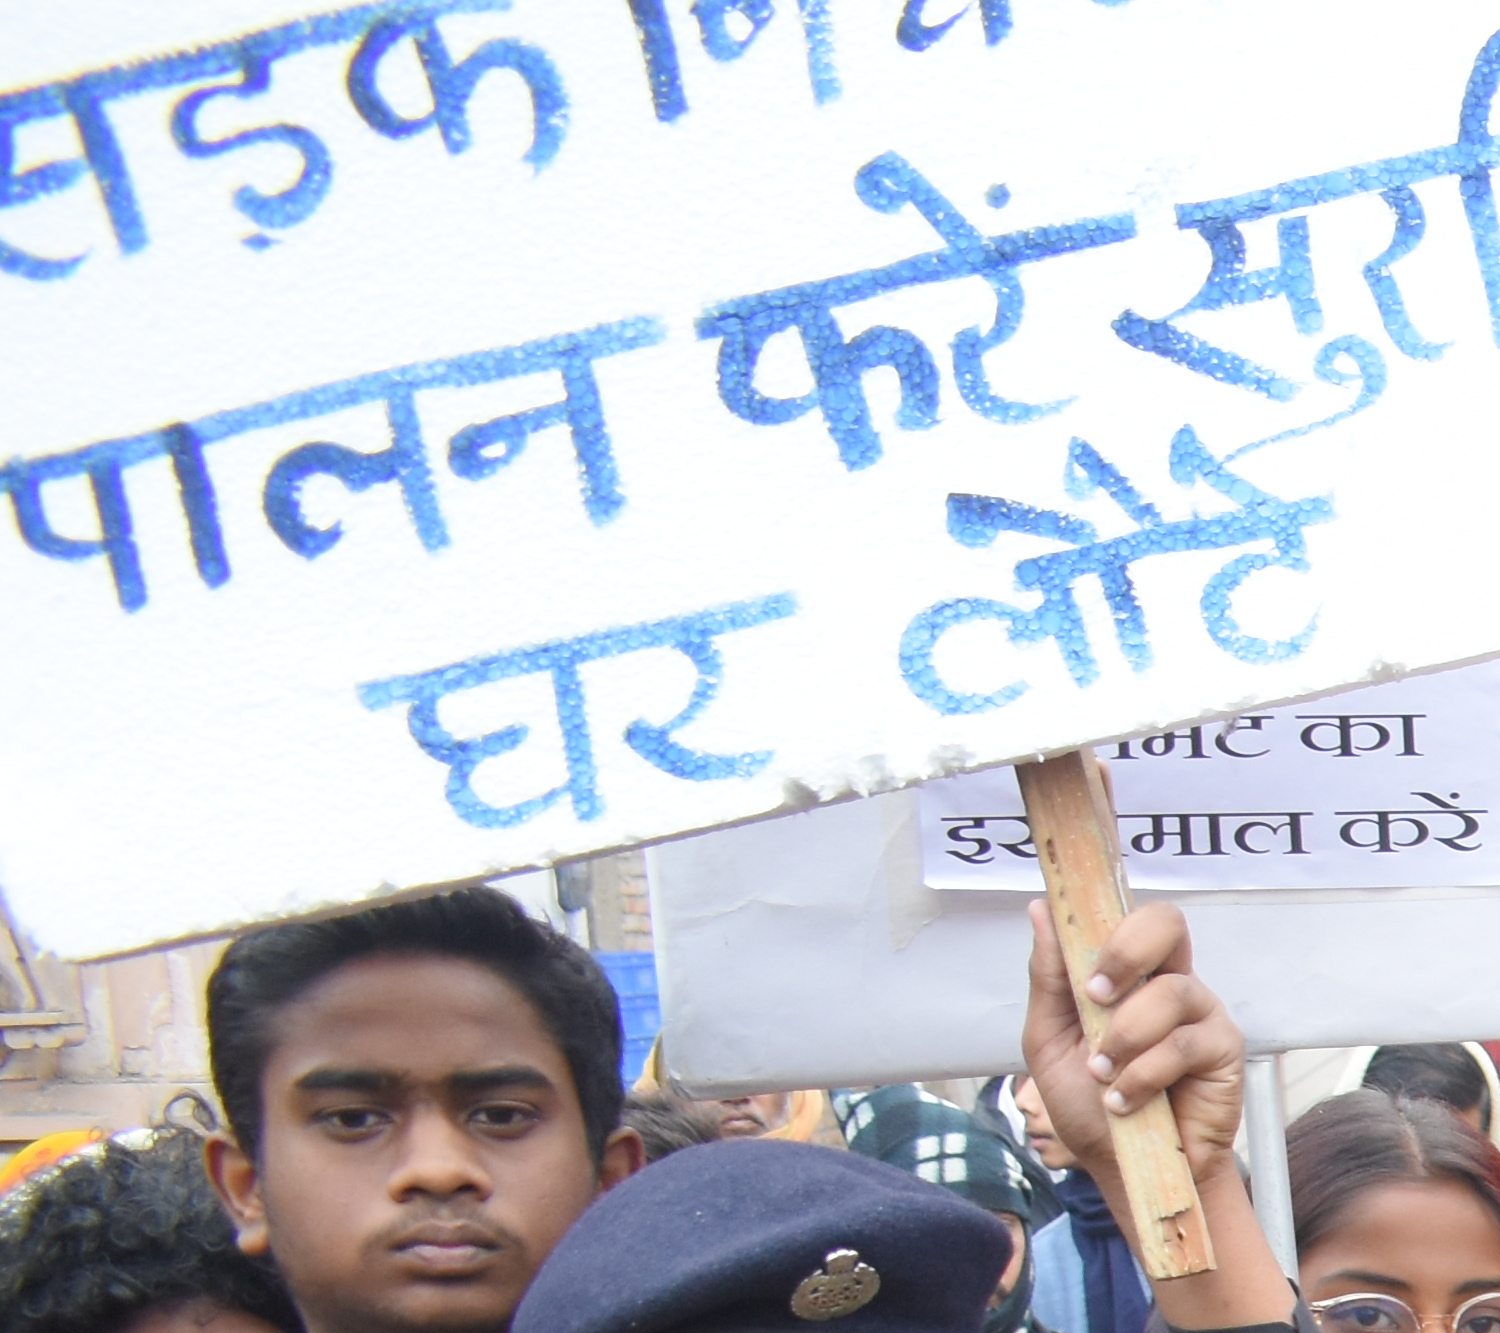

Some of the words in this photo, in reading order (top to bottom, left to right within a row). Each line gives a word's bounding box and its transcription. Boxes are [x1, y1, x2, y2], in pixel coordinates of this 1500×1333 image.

[0, 314, 666, 616] पालन
[694, 150, 1137, 473] करें
[357, 591, 798, 829] घर
[1295, 711, 1428, 759] का
[1333, 790, 1489, 854] करें
